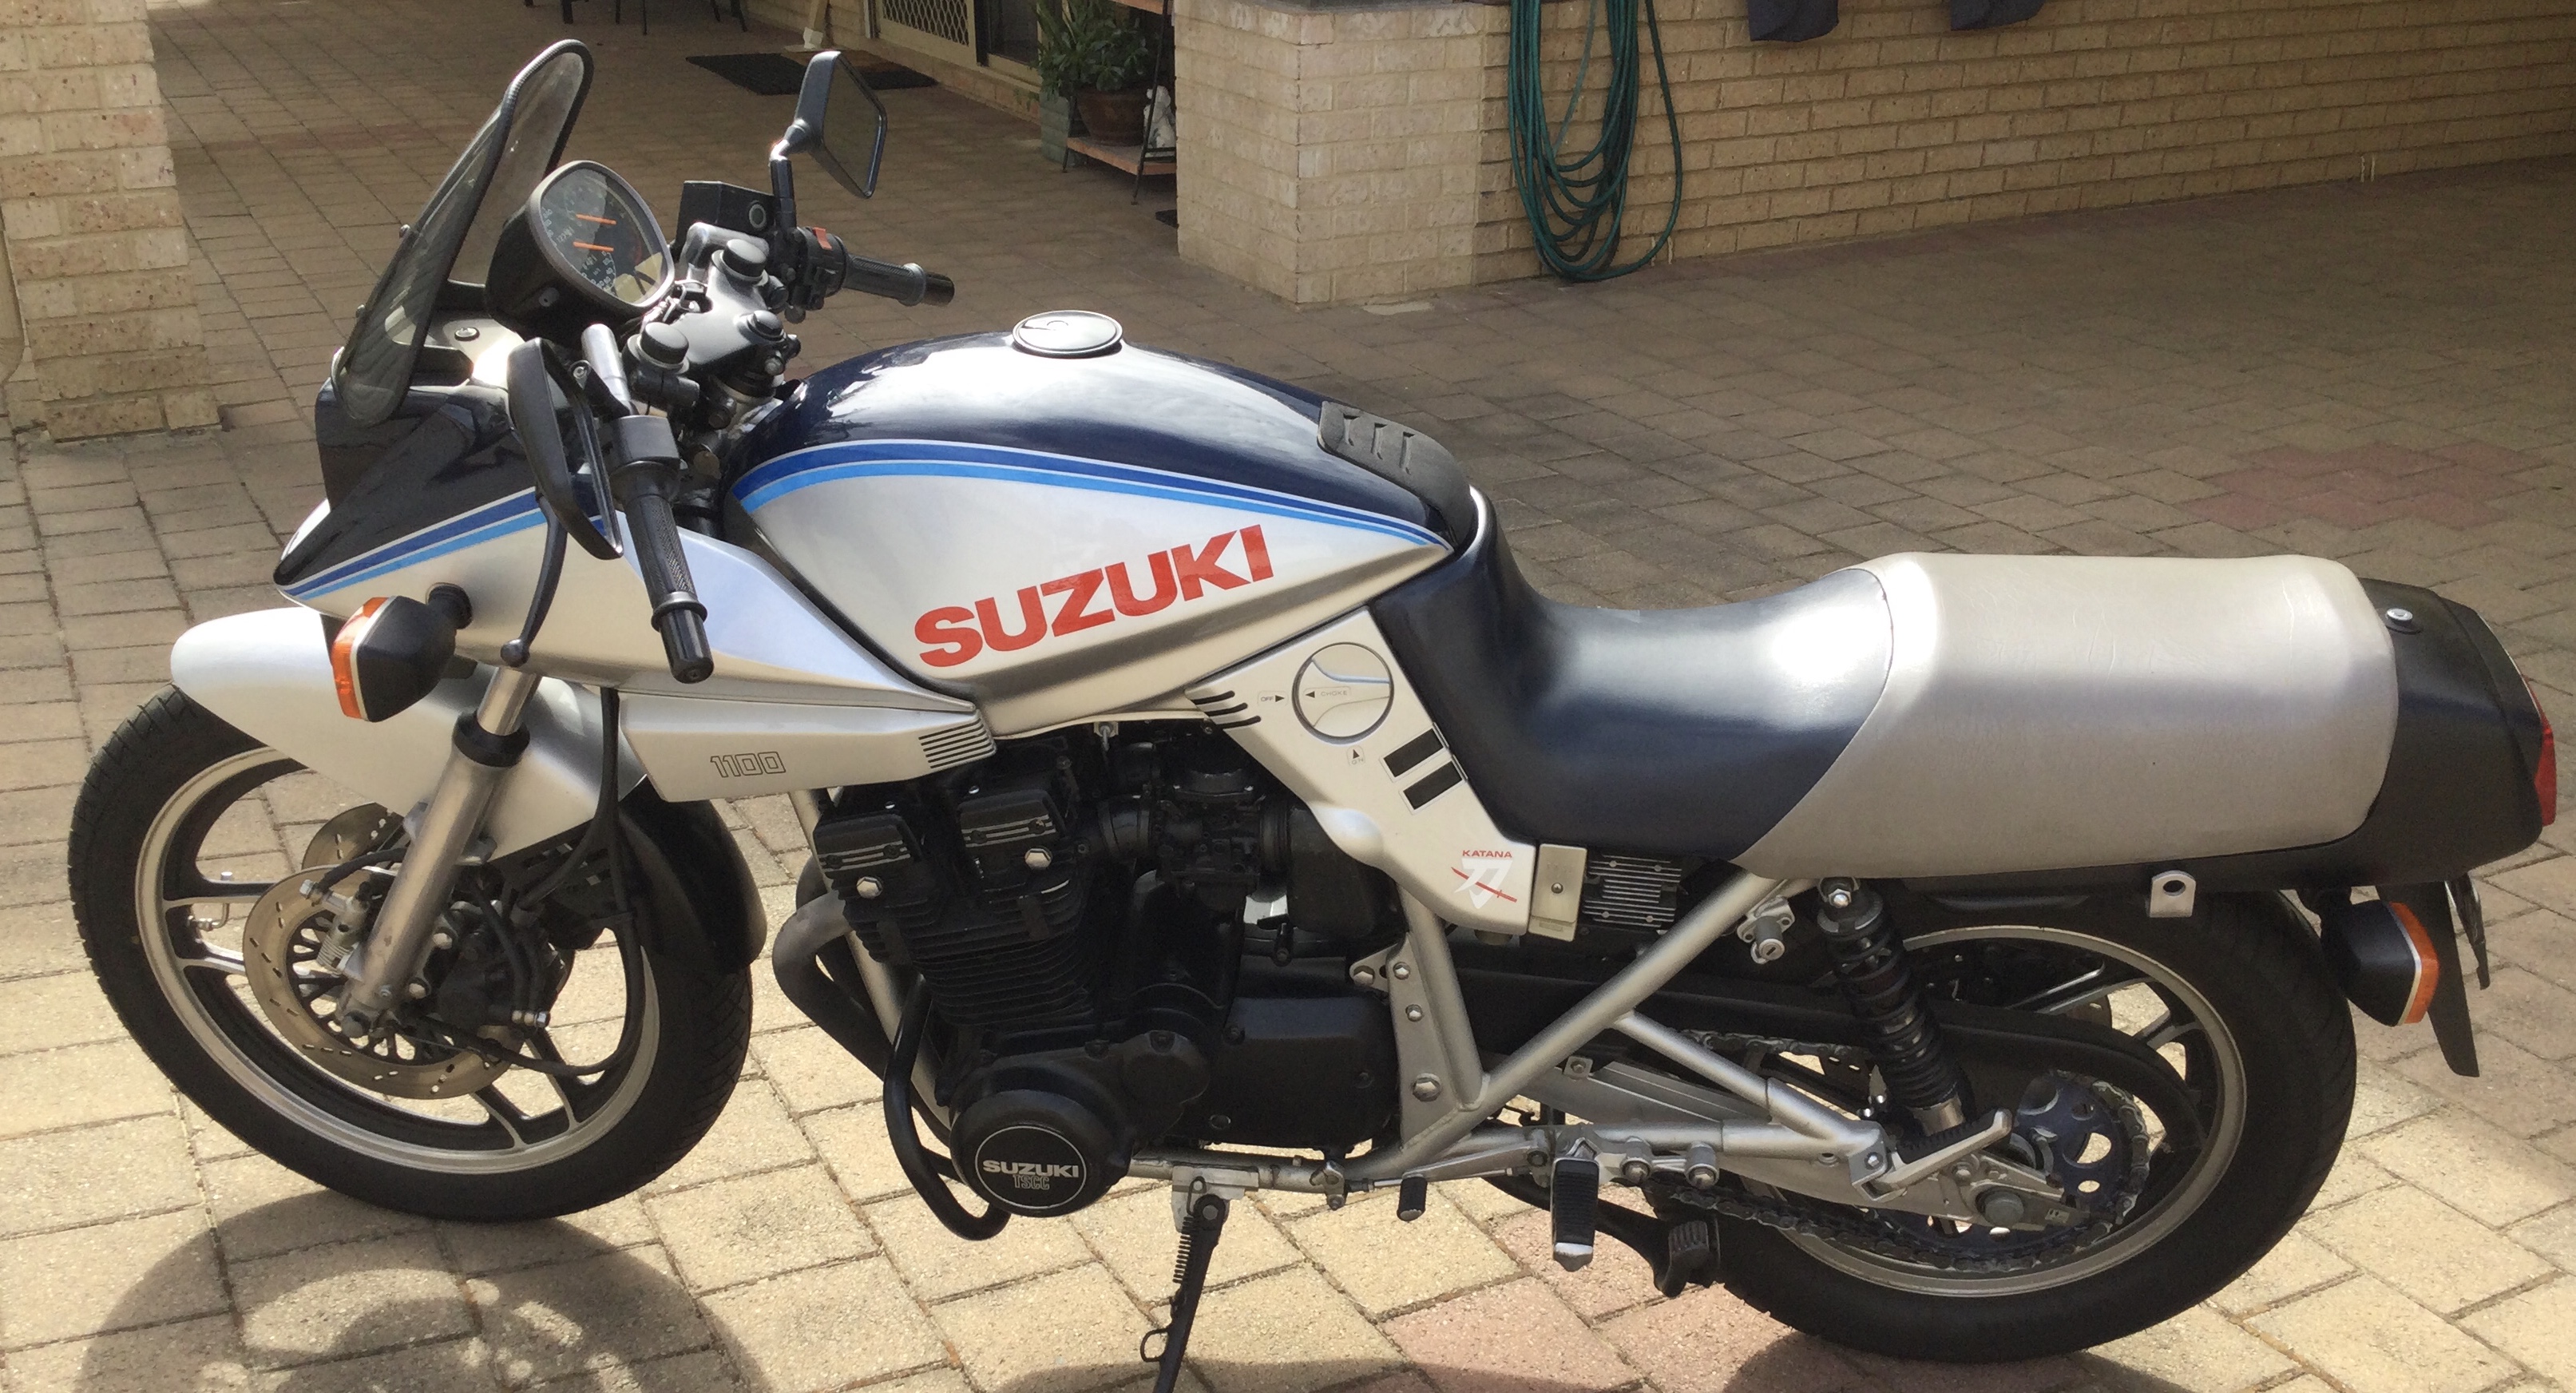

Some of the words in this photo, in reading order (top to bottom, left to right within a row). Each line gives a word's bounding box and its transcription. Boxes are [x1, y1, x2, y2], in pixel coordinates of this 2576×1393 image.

[914, 524, 1274, 667] SUZUKI
[710, 752, 787, 778] 1100
[1462, 849, 1512, 859] KATANA
[982, 1160, 1079, 1178] SUZUKI
[1013, 1174, 1050, 1190] TSCC
